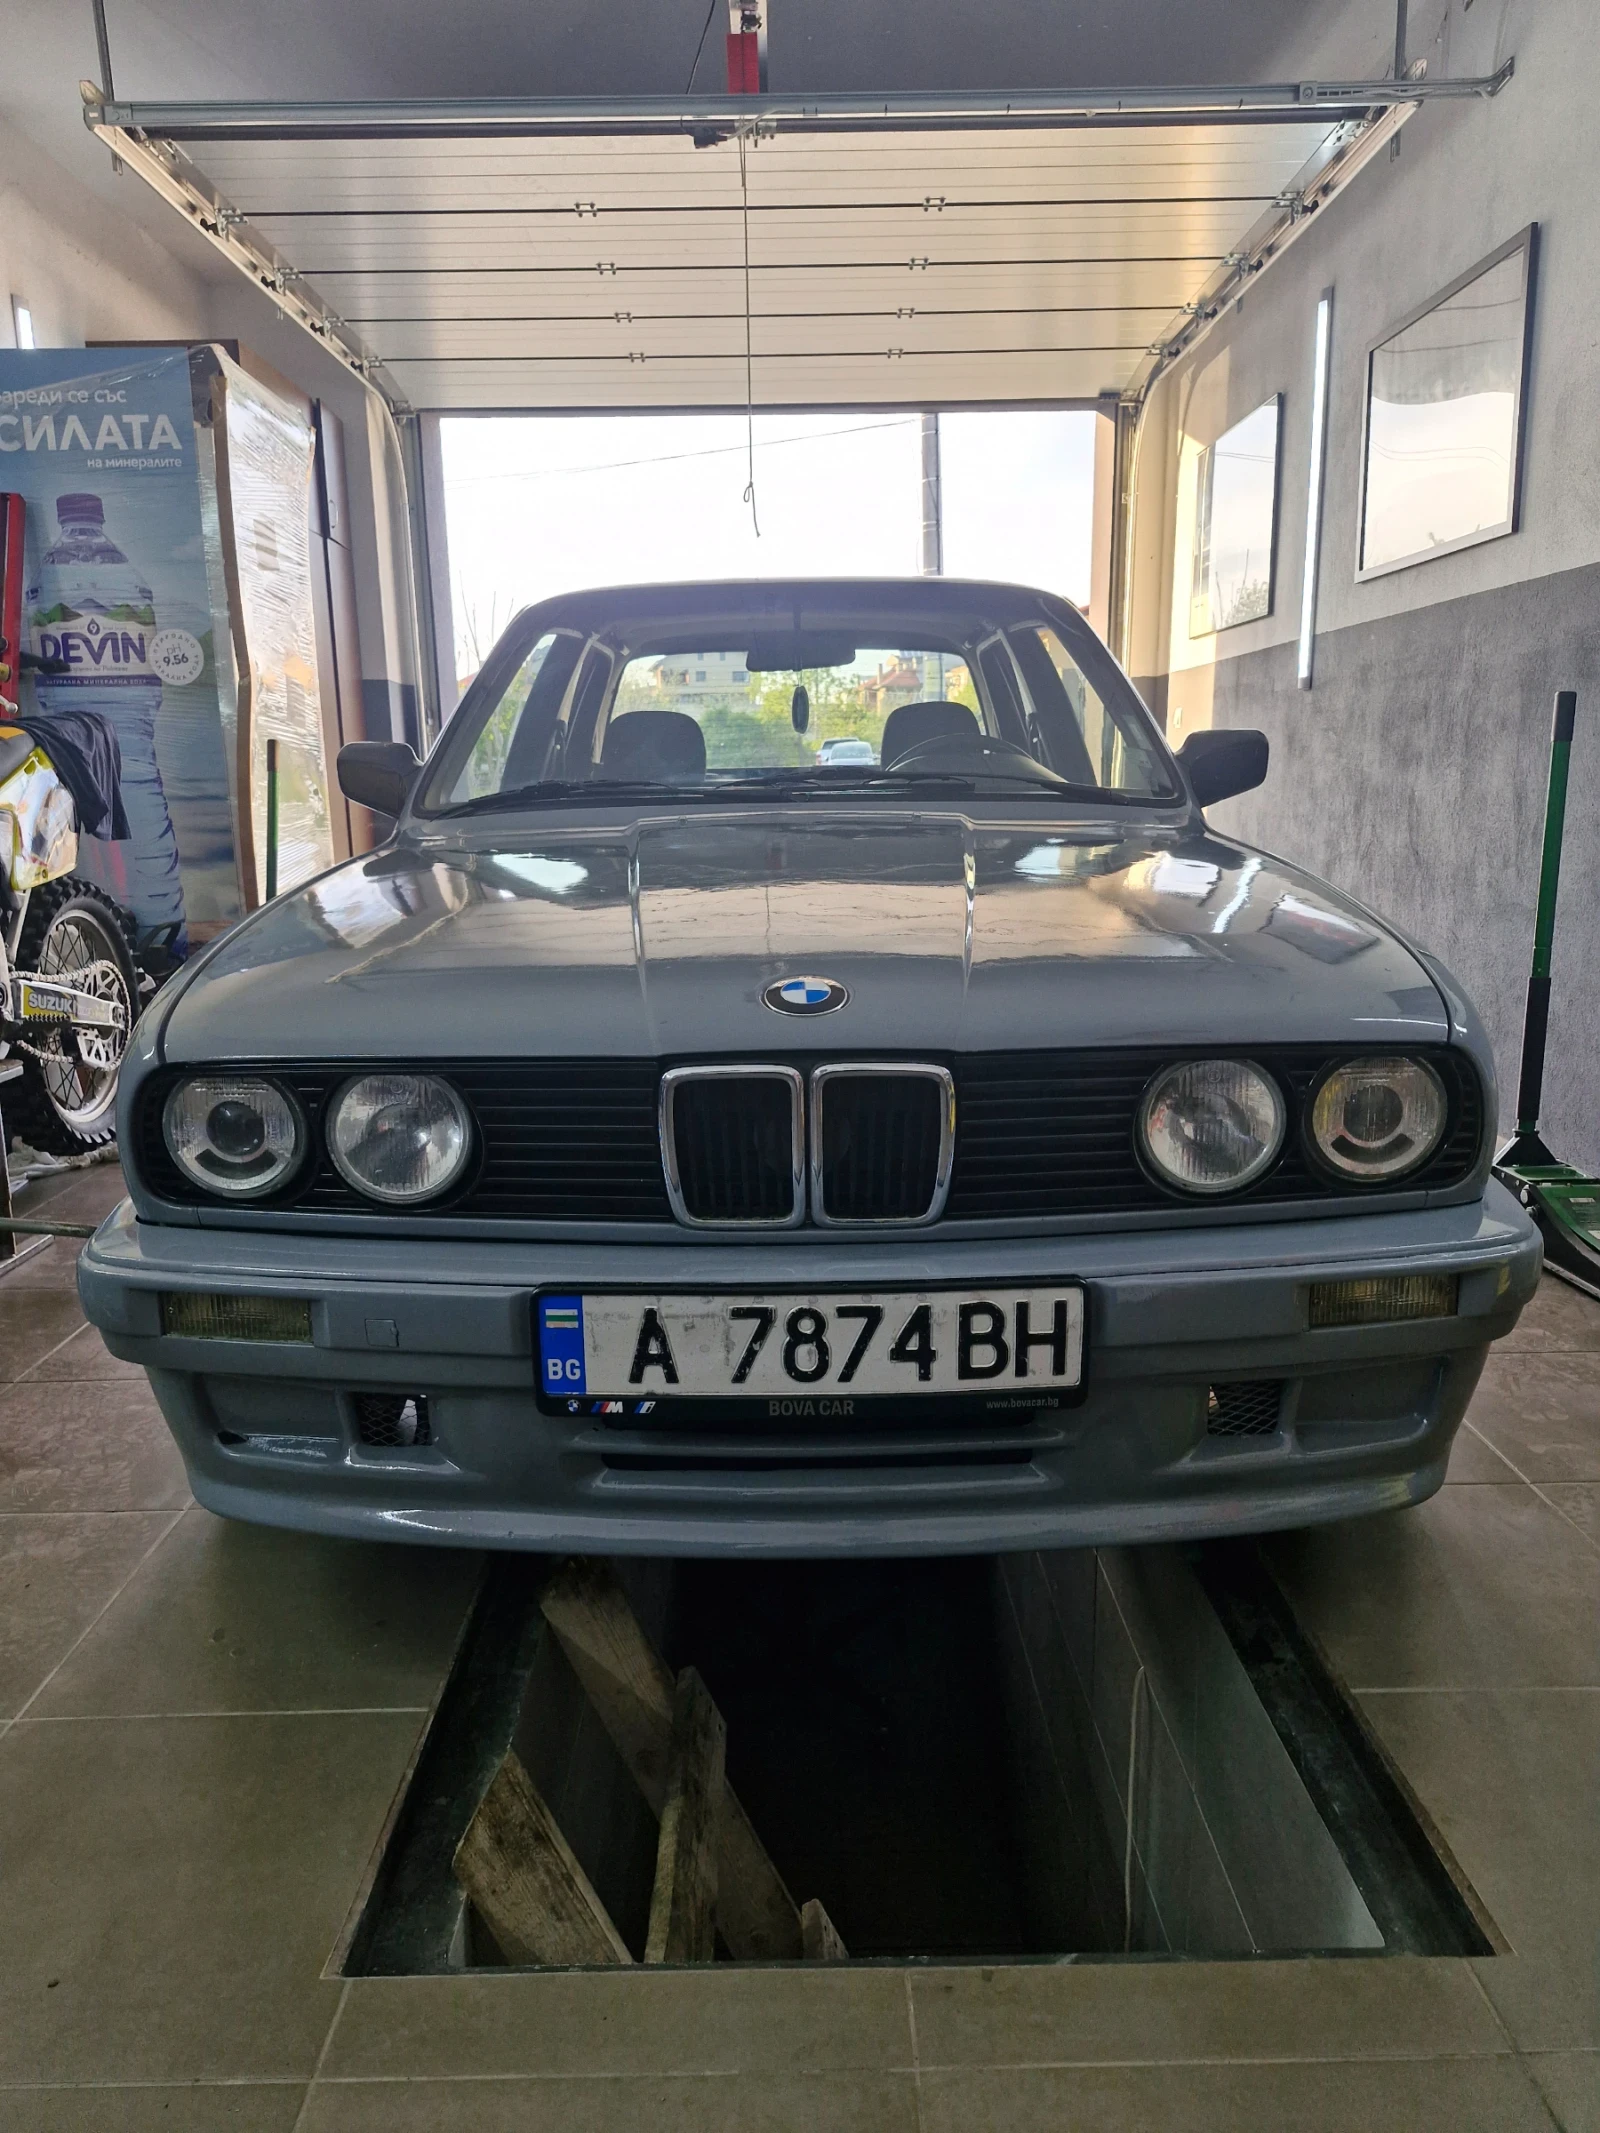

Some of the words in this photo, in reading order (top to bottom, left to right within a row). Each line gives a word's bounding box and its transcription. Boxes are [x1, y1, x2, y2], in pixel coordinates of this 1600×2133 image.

[0, 390, 62, 409] ареди
[68, 390, 89, 403] се
[94, 389, 127, 403] със
[0, 414, 183, 452] СИЛАТА
[87, 458, 102, 468] на
[106, 458, 182, 470] минералите
[40, 631, 147, 665] DEVIN
[167, 643, 181, 655] pH
[163, 653, 189, 666] 9.56
[728, 1303, 938, 1384] 7874
[547, 1358, 581, 1381] BG
[768, 1400, 815, 1416] BOVA
[819, 1400, 854, 1416] CAR
[986, 1397, 1059, 1409] www.bovacar.bg
